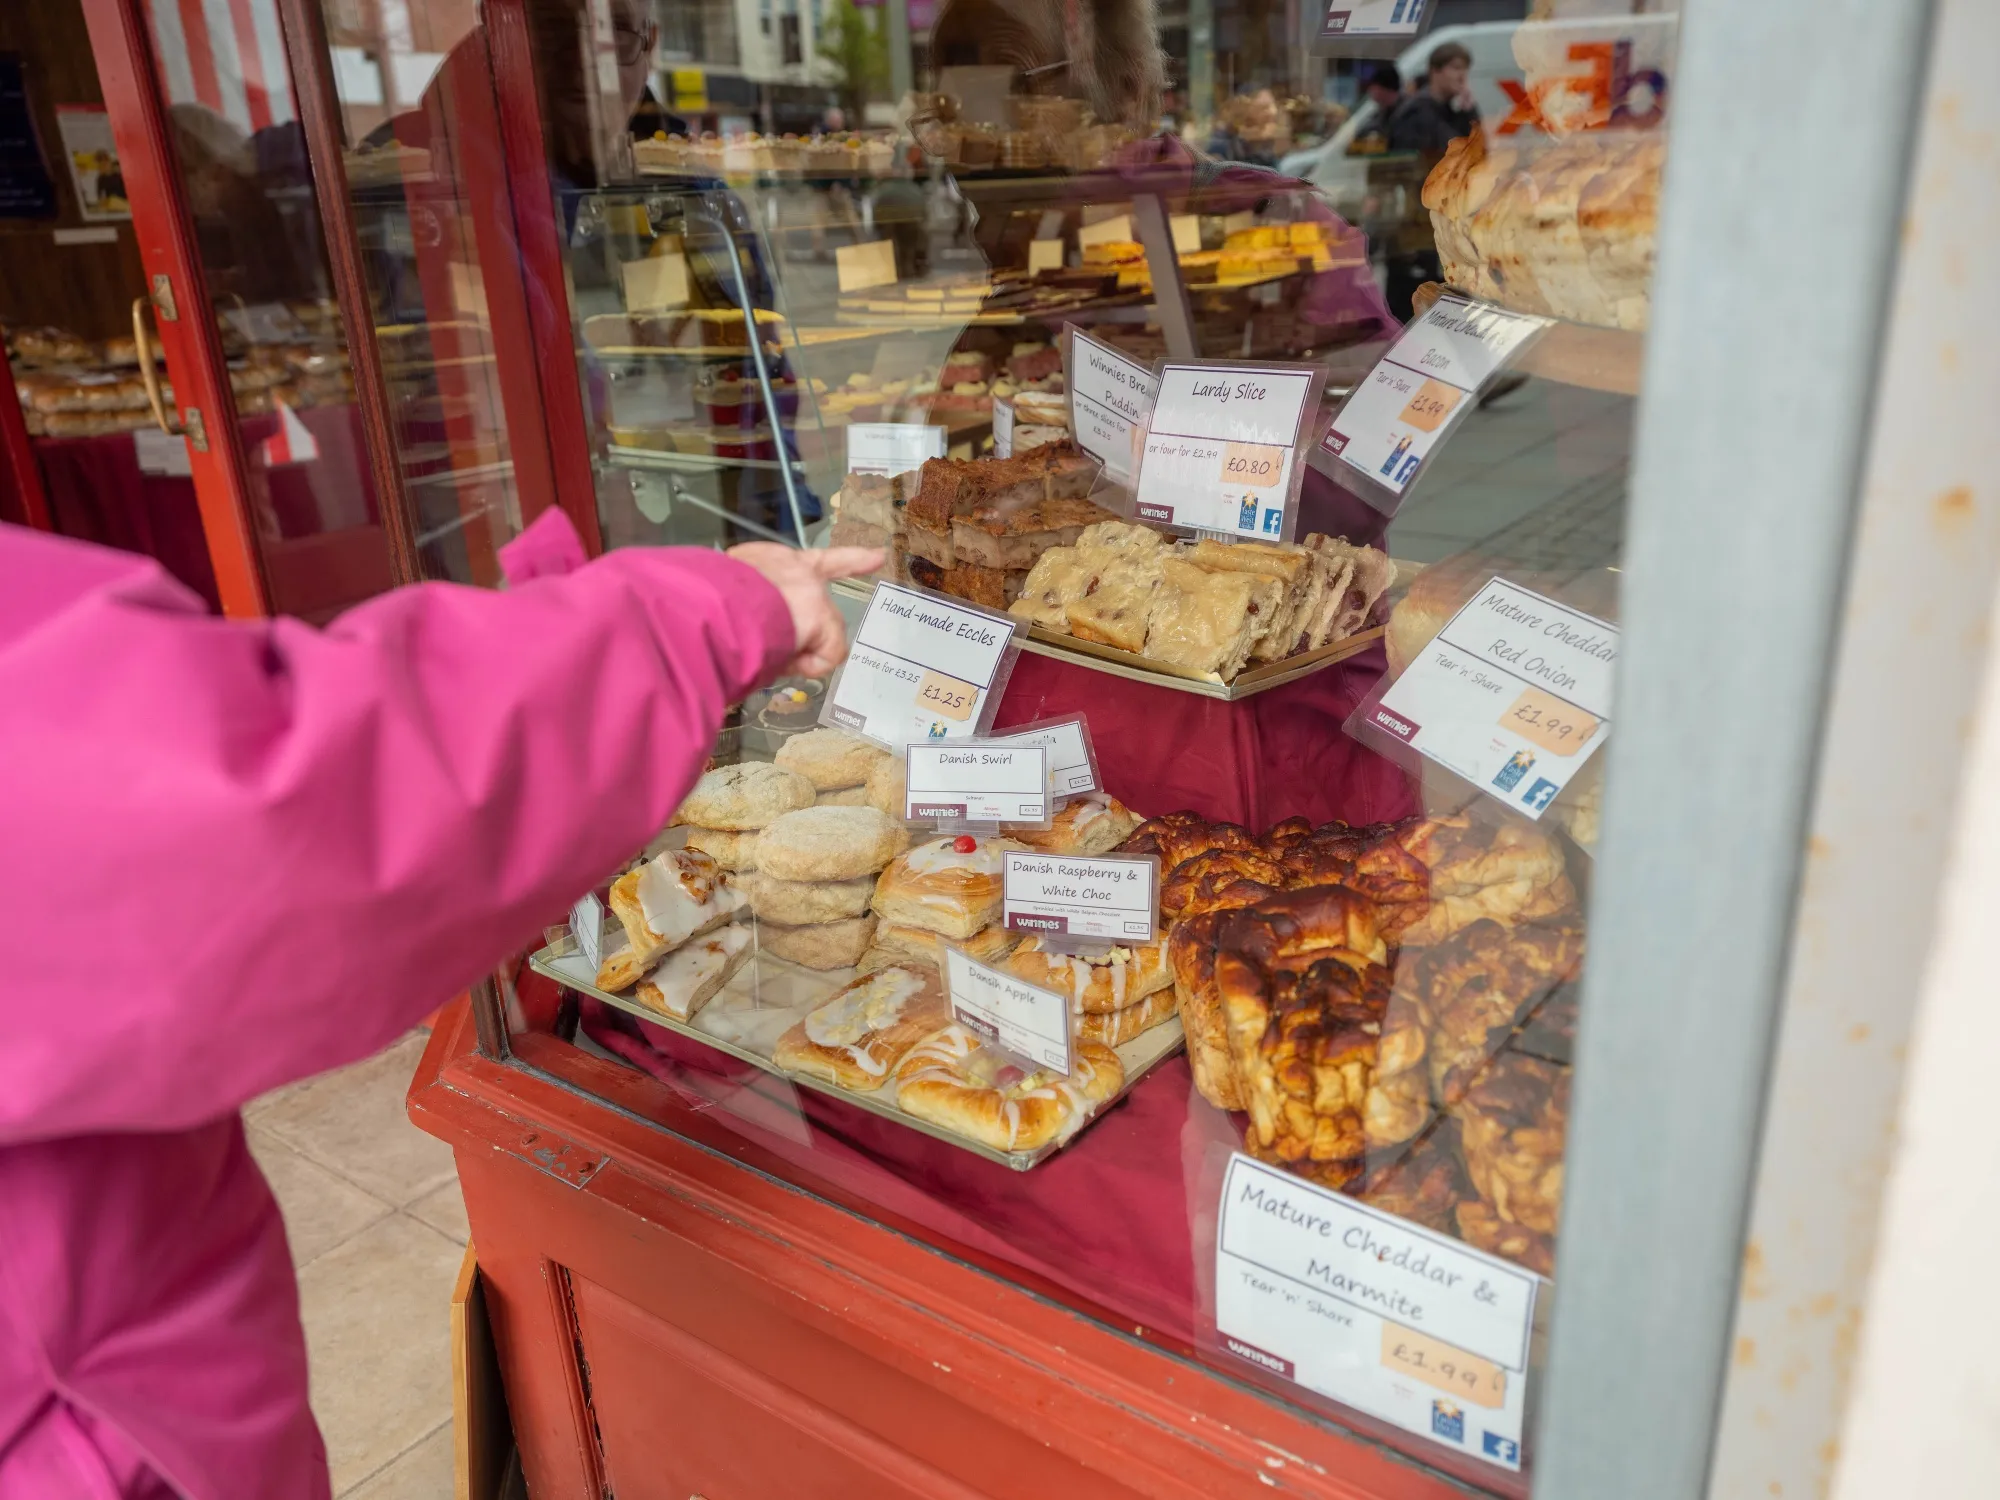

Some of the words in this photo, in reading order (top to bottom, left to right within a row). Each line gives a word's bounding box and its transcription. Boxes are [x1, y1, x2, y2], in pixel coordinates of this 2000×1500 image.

[1424, 310, 1455, 331] Mature
[1089, 353, 1126, 383] Winnies
[1419, 348, 1452, 370] Bacon
[1192, 380, 1232, 403] Lardy
[1235, 382, 1267, 401] Slice
[1393, 378, 1412, 394] Share
[1410, 395, 1444, 418] £1.99
[1116, 420, 1126, 434] for
[1149, 444, 1159, 453] or
[1159, 442, 1175, 455] four
[1178, 444, 1189, 457] for
[1192, 450, 1218, 459] £2.99
[1227, 457, 1271, 475] £0.80
[880, 597, 953, 634] Hand-made
[956, 622, 997, 647] Eccles
[1481, 594, 1543, 629] Mature
[1543, 622, 1618, 663] Cheddar
[851, 652, 860, 662] or
[861, 655, 881, 671] three
[882, 661, 894, 676] for
[895, 667, 921, 684] £3.25
[1435, 652, 1458, 670] Tear
[1471, 672, 1503, 695] Share
[1488, 638, 1525, 665] Red
[1525, 657, 1578, 691] Onion
[922, 684, 965, 709] £1.25
[1514, 704, 1573, 740] £1.99
[939, 753, 978, 765] Danish
[981, 753, 1013, 765] Swirl
[918, 807, 960, 818] winnies
[1013, 861, 1054, 875] Danish
[1058, 864, 1121, 882] Raspberry
[1126, 870, 1138, 880] &
[1042, 885, 1077, 898] White
[1082, 887, 1112, 901] Choc
[1016, 917, 1060, 930] winnies
[1005, 985, 1036, 1004] Apple
[1240, 1183, 1332, 1238] Mature
[1343, 1226, 1465, 1289] Cheddar
[1473, 1280, 1500, 1307] &
[1240, 1272, 1276, 1296] Tear
[1306, 1298, 1354, 1329] Share
[1306, 1258, 1425, 1322] Marmite
[1392, 1343, 1479, 1389] £1.99
